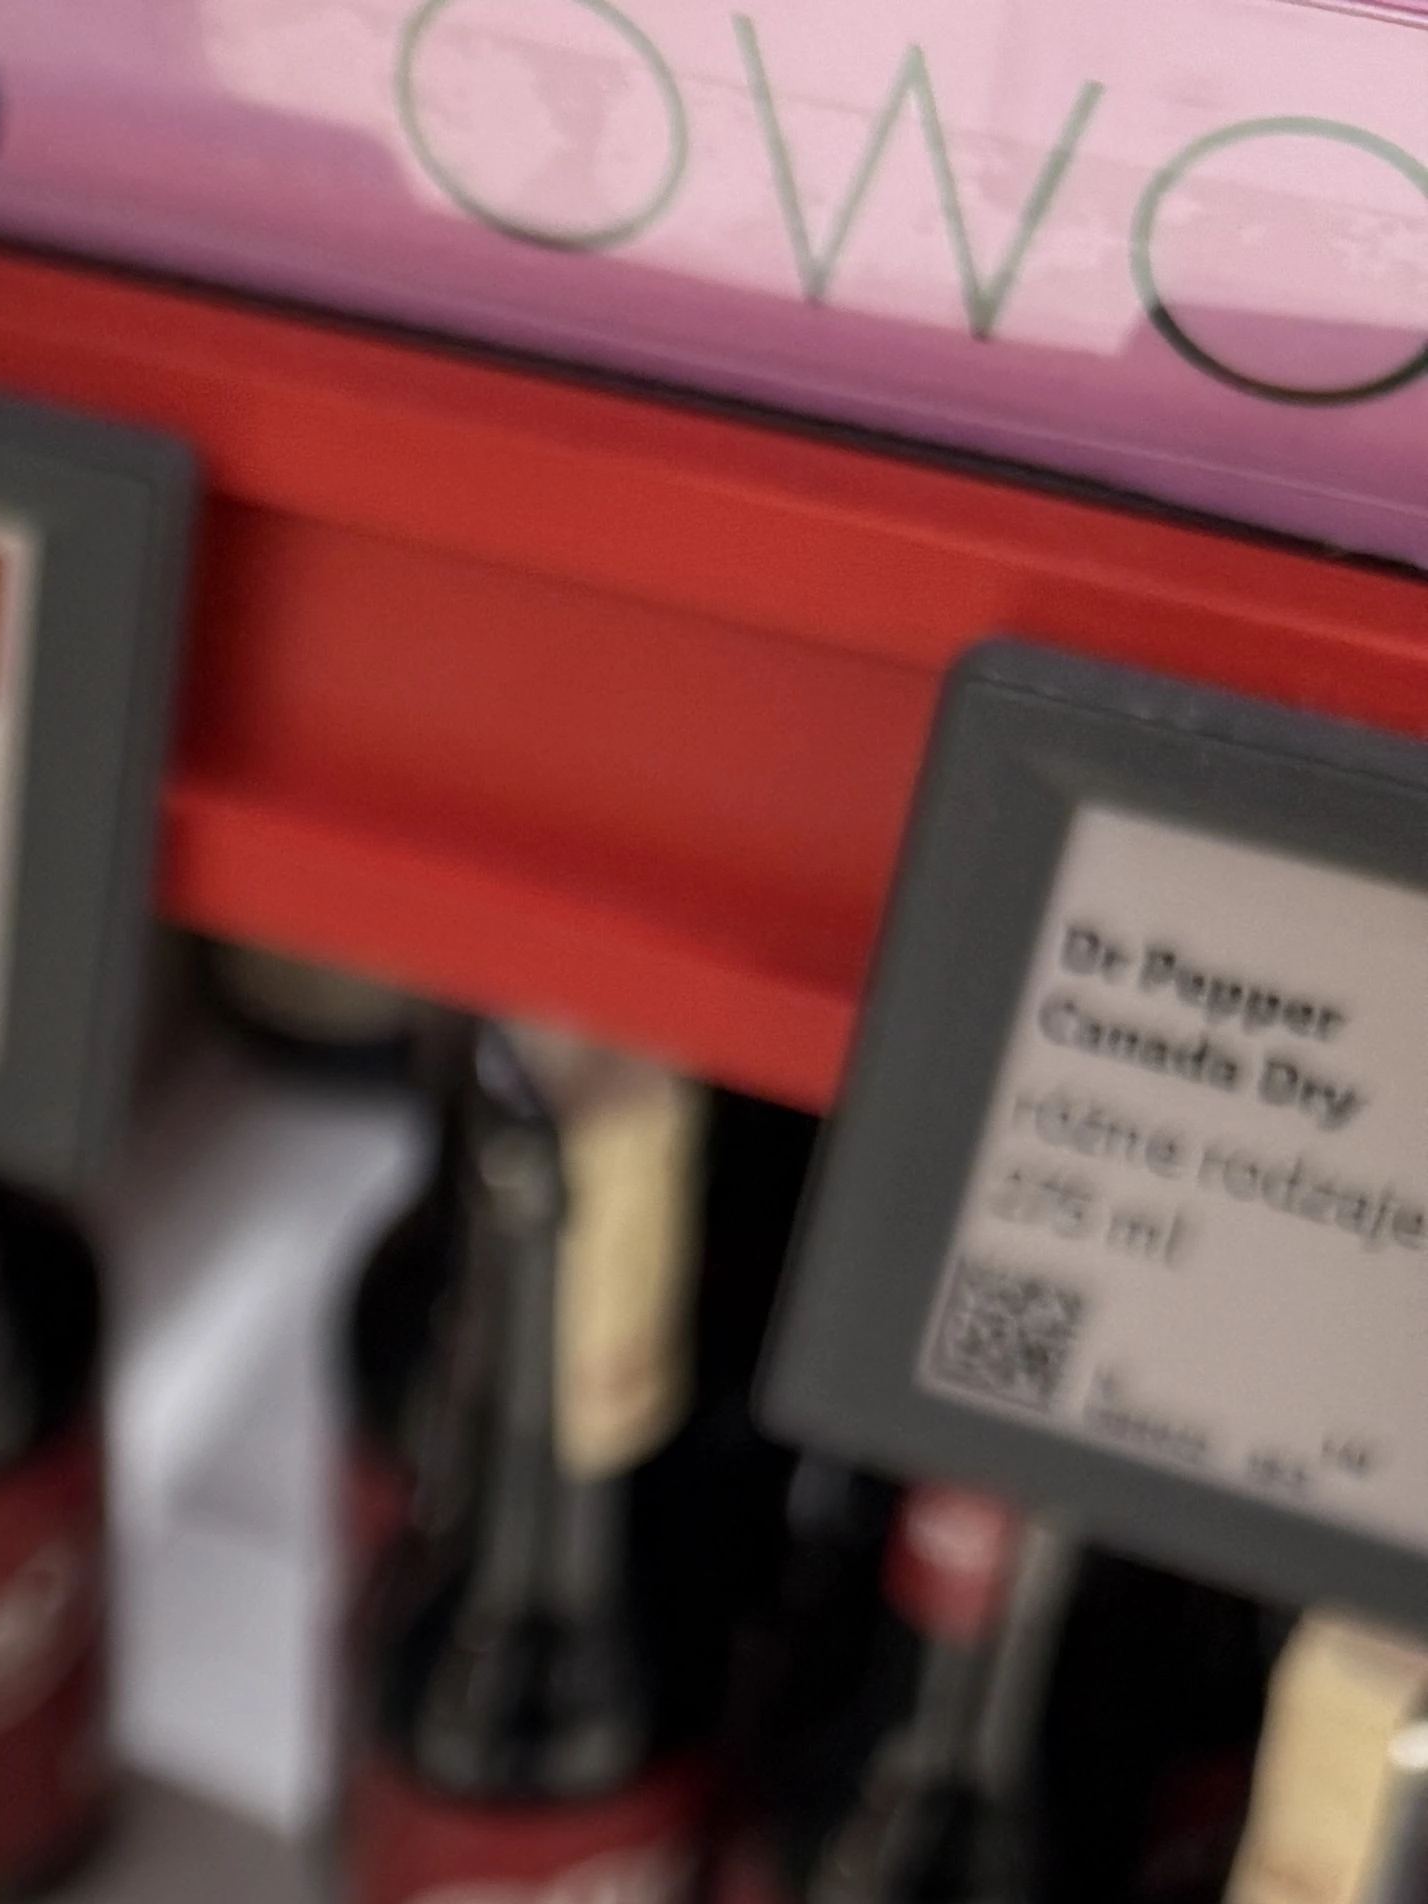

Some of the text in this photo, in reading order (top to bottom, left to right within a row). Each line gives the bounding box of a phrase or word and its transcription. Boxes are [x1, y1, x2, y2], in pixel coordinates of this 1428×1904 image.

[1060, 922, 1350, 1046] Dr Pepper
[1036, 998, 1362, 1136] Canada Dry
